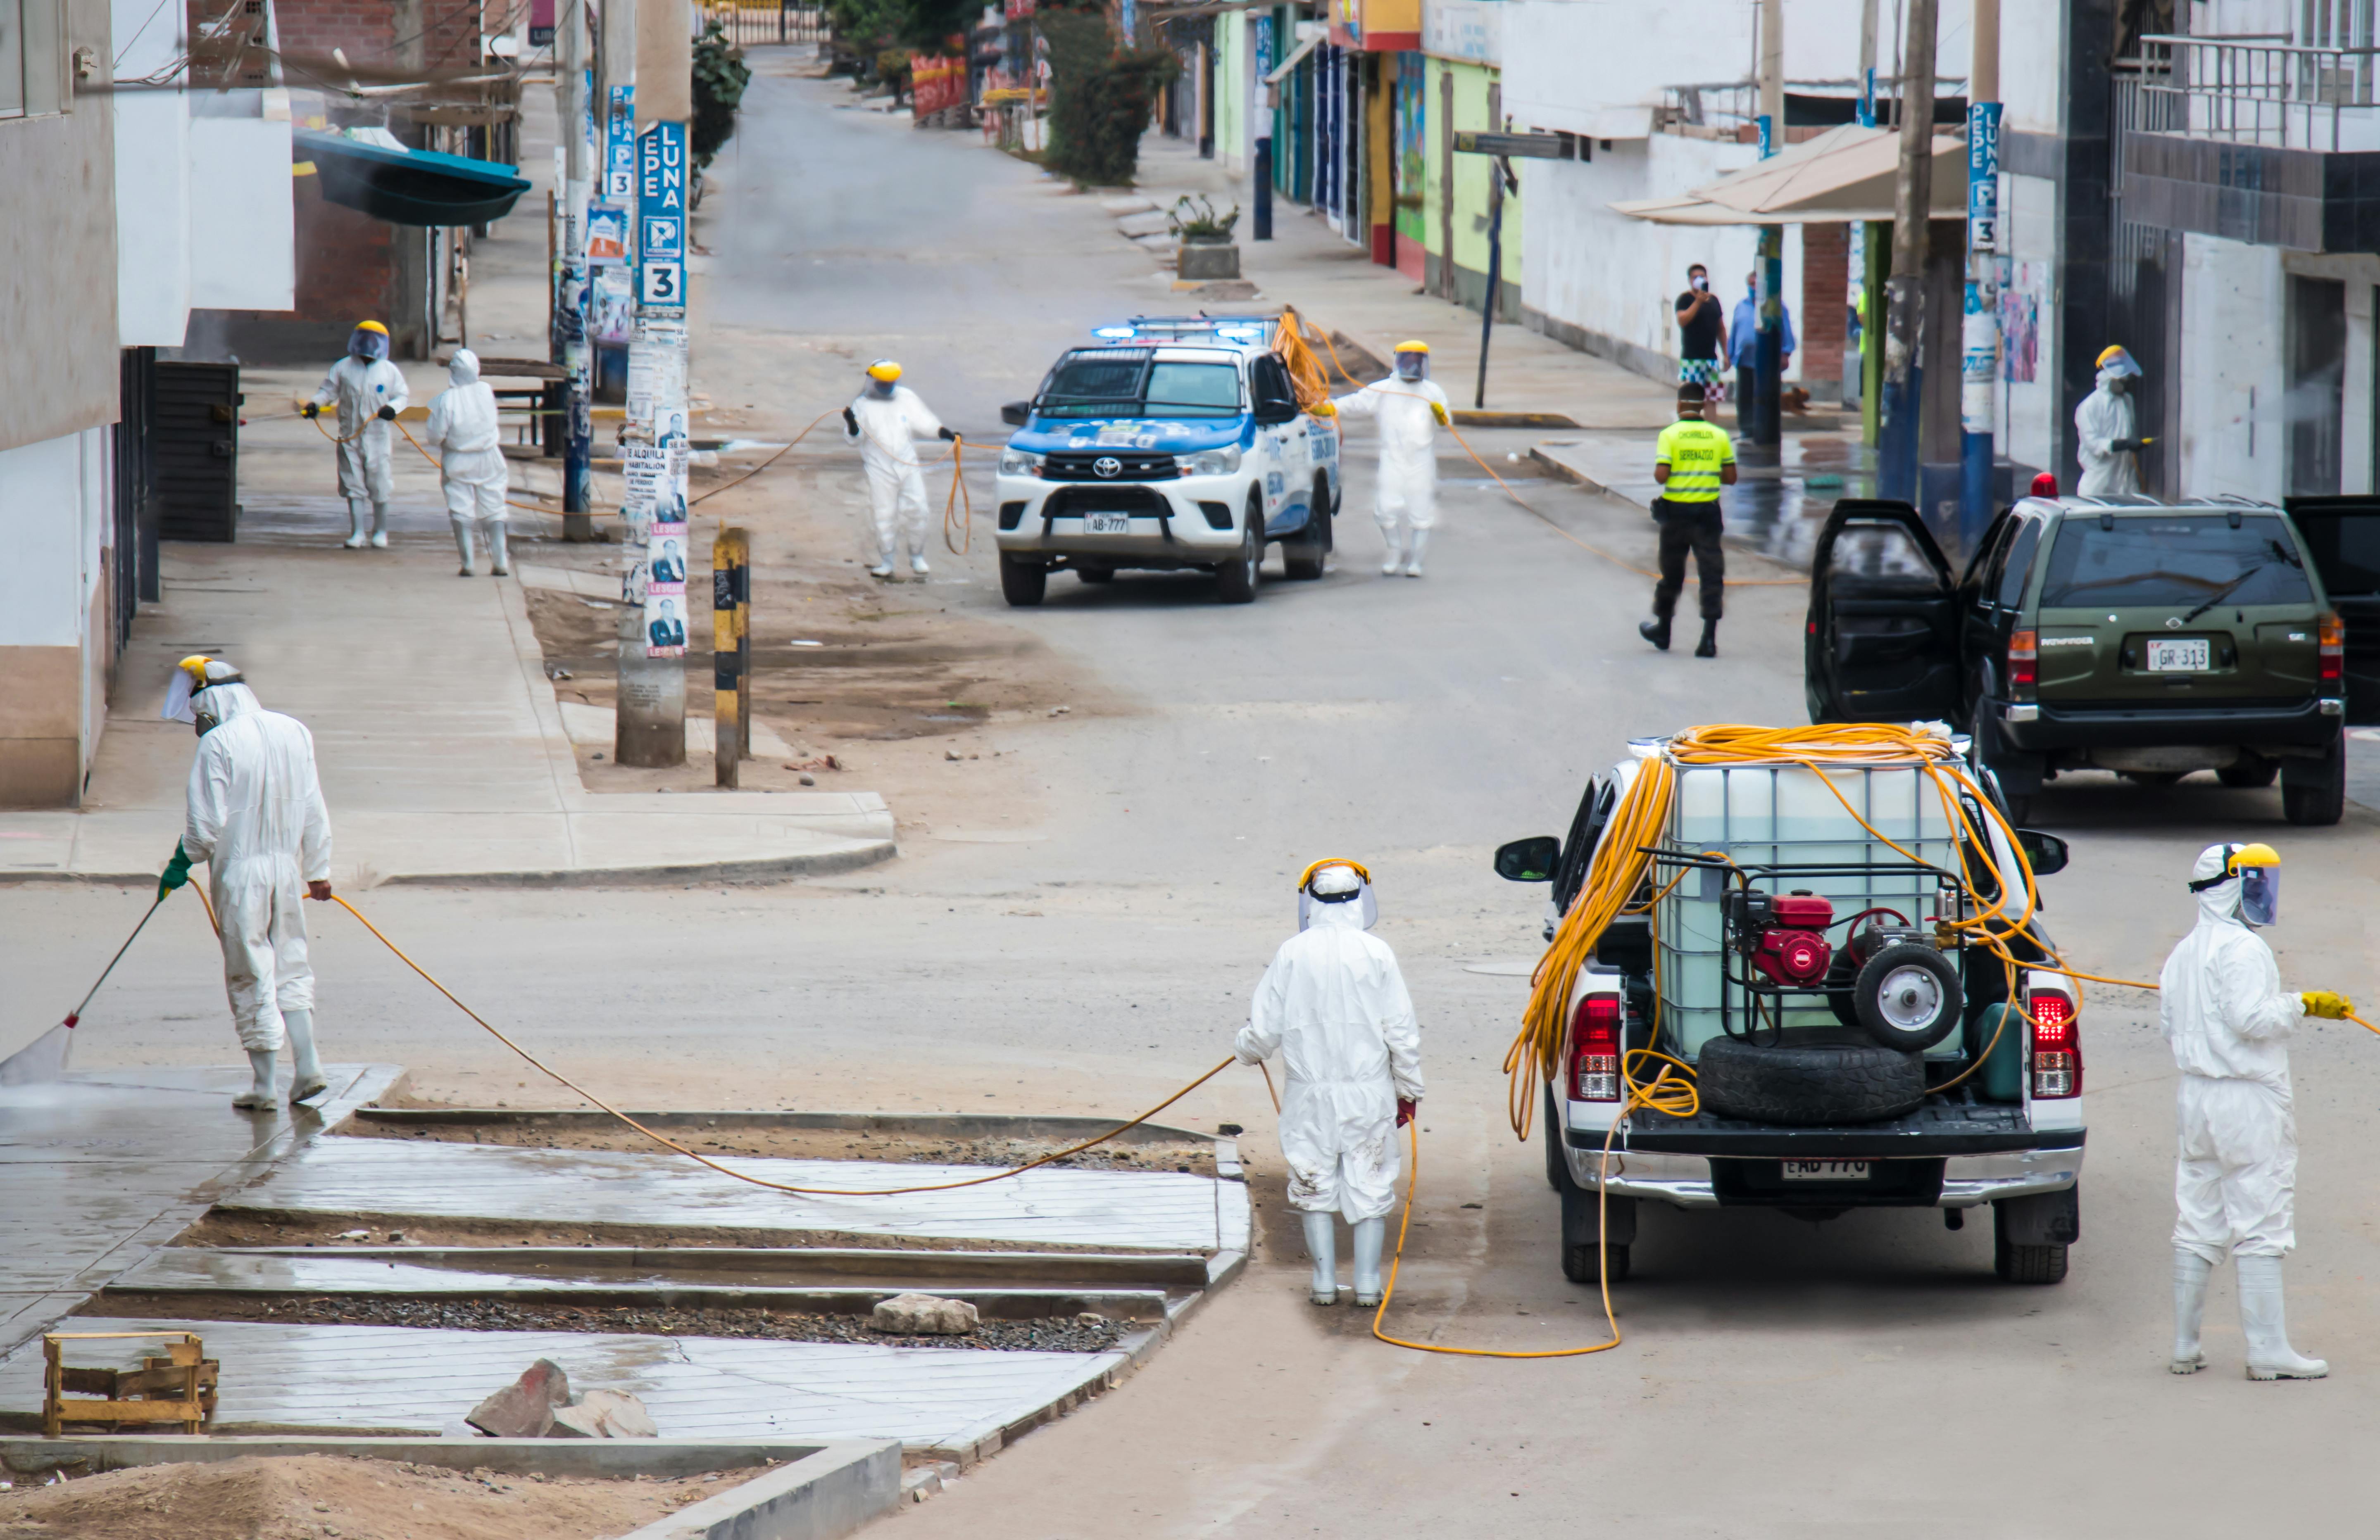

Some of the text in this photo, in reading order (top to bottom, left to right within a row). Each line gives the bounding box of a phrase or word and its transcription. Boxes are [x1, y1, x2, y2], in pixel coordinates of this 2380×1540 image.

[1972, 104, 1985, 168] PEPE
[1985, 113, 1997, 176] LUNA
[644, 135, 660, 197] EPE
[662, 126, 680, 208] LUNA
[615, 176, 628, 192] 3
[1978, 222, 1994, 244] 3
[652, 268, 674, 297] 3
[1679, 431, 1714, 440] CHORRILLOS
[633, 449, 664, 459] ALQUILA
[1679, 449, 1714, 461] SERENAZGO
[1092, 518, 1126, 531] AB-777
[2160, 649, 2206, 665] GR-313
